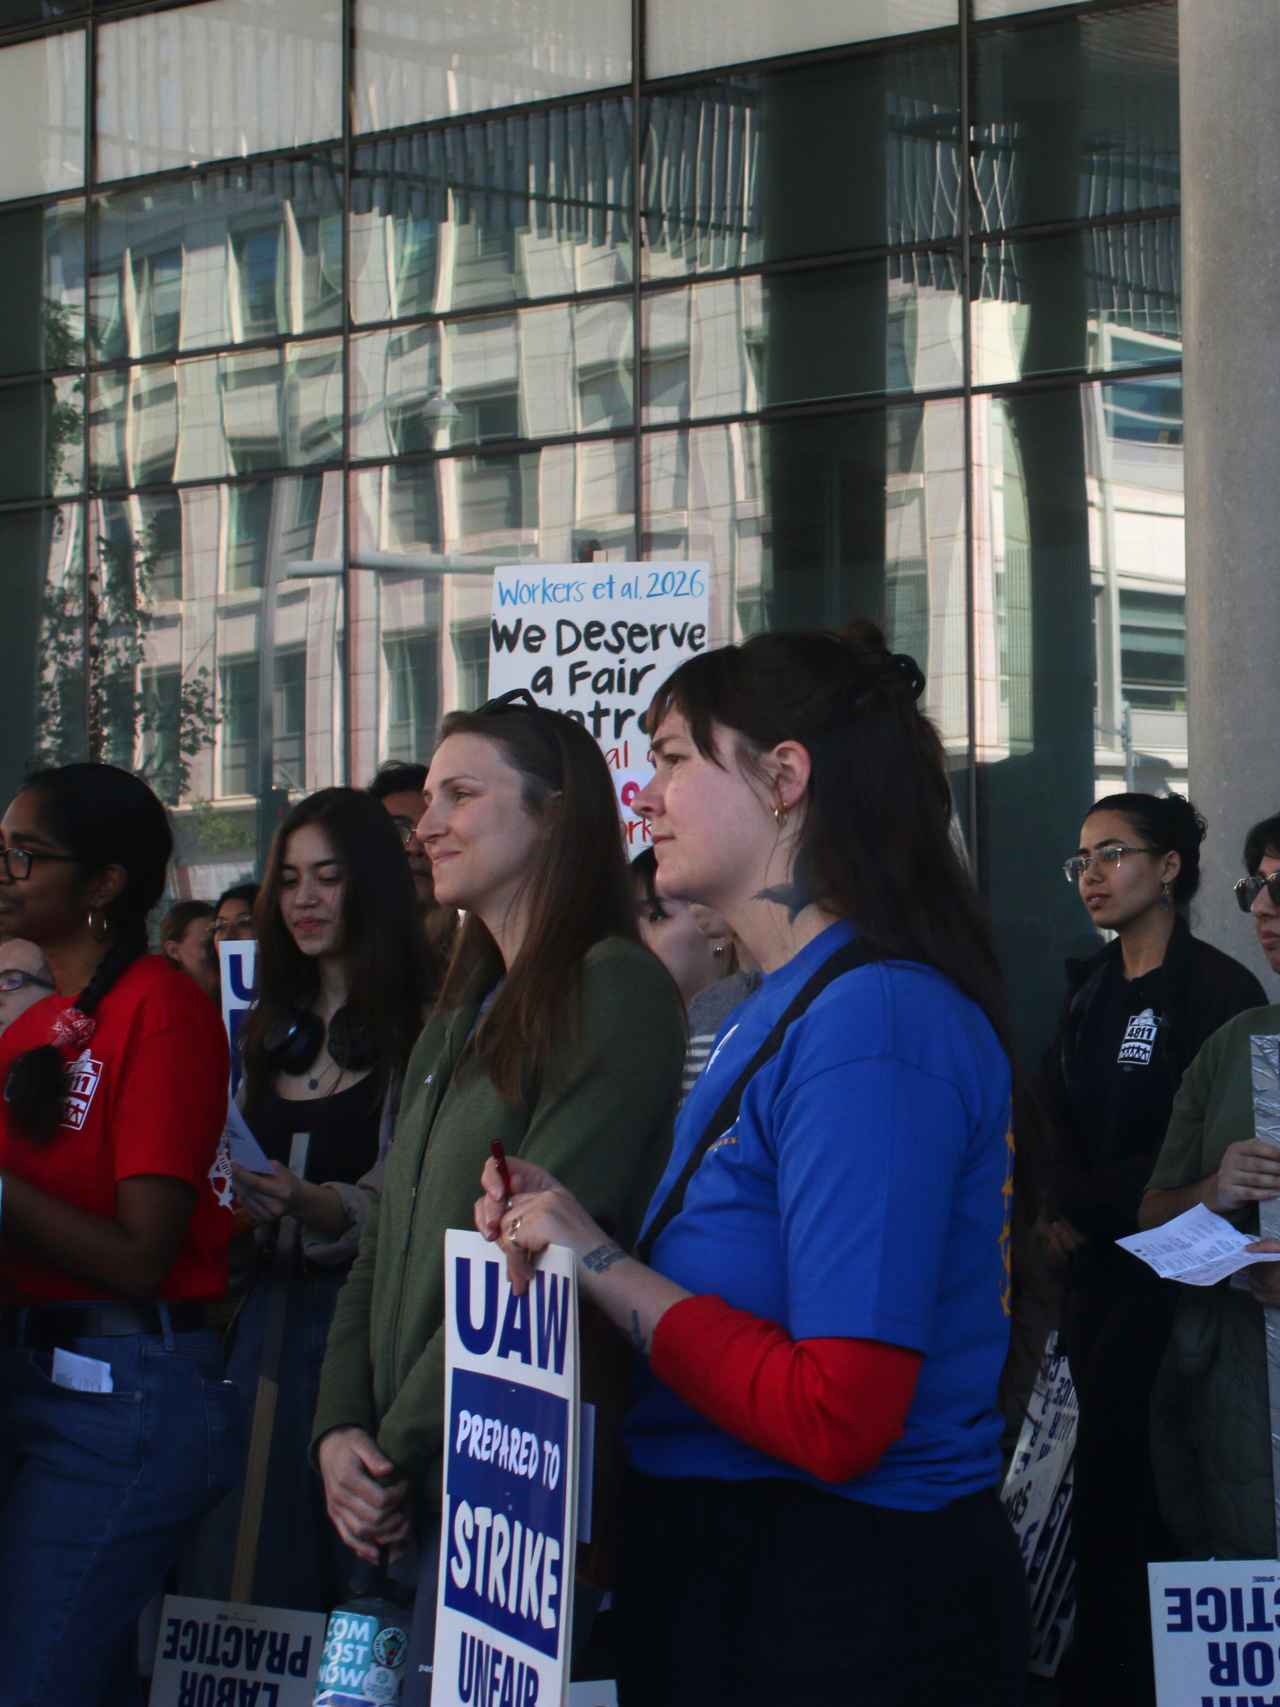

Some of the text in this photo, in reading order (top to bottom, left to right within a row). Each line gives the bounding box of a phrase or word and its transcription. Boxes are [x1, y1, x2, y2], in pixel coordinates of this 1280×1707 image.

[498, 576, 588, 606] Workers
[592, 574, 615, 600] et
[646, 569, 705, 599] 2026
[491, 616, 707, 656] We Deserve
[531, 658, 657, 696] a Fair
[1127, 1027, 1154, 1039] 4811
[455, 1256, 571, 1376] UAW
[456, 1409, 561, 1490] PREPARED TO
[451, 1499, 560, 1630] STRIKE
[163, 1617, 312, 1678] PRACTICE
[458, 1631, 539, 1707] UNFAIR
[178, 1670, 280, 1707] LABOR
